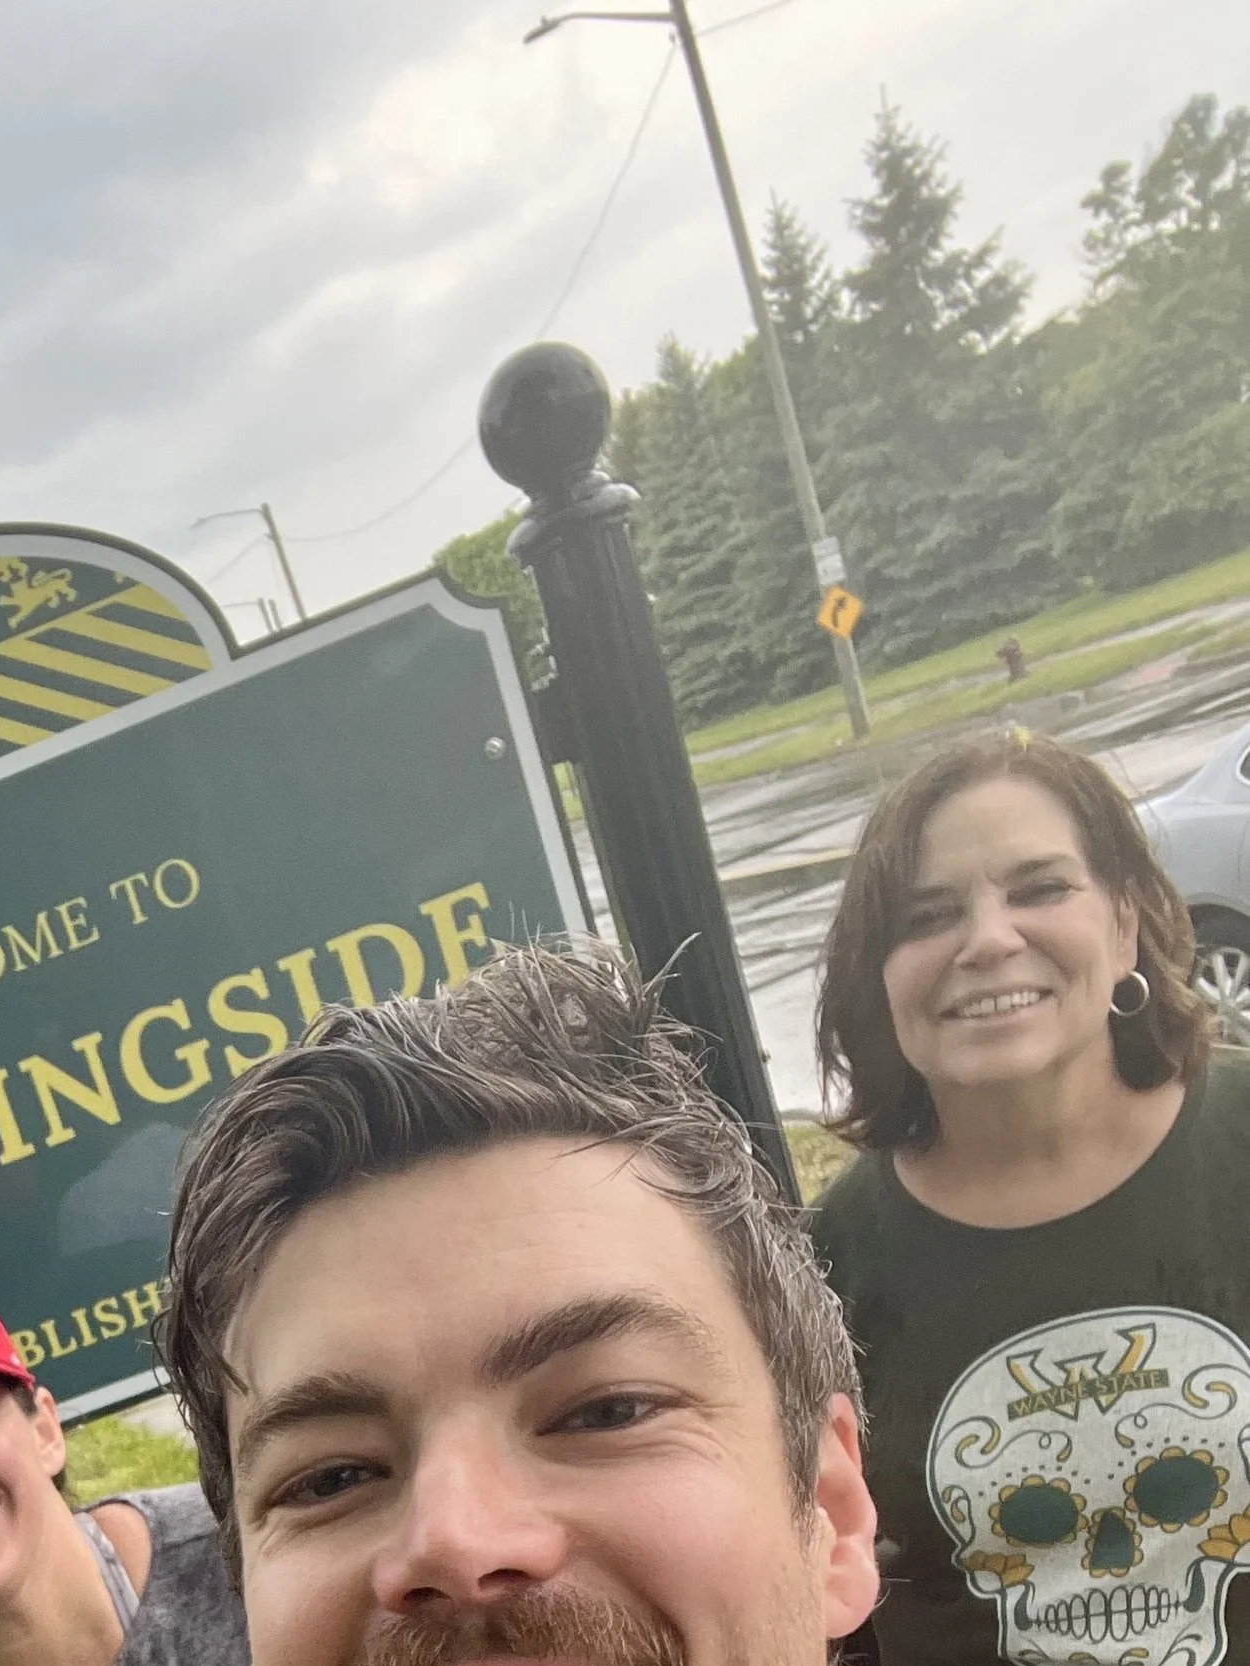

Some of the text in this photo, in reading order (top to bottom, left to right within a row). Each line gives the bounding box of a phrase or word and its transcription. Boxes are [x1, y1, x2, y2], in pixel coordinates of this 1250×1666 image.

[109, 857, 202, 926] TO
[9, 1279, 164, 1369] BLISH
[1013, 1370, 1163, 1416] WAYNE STATE
